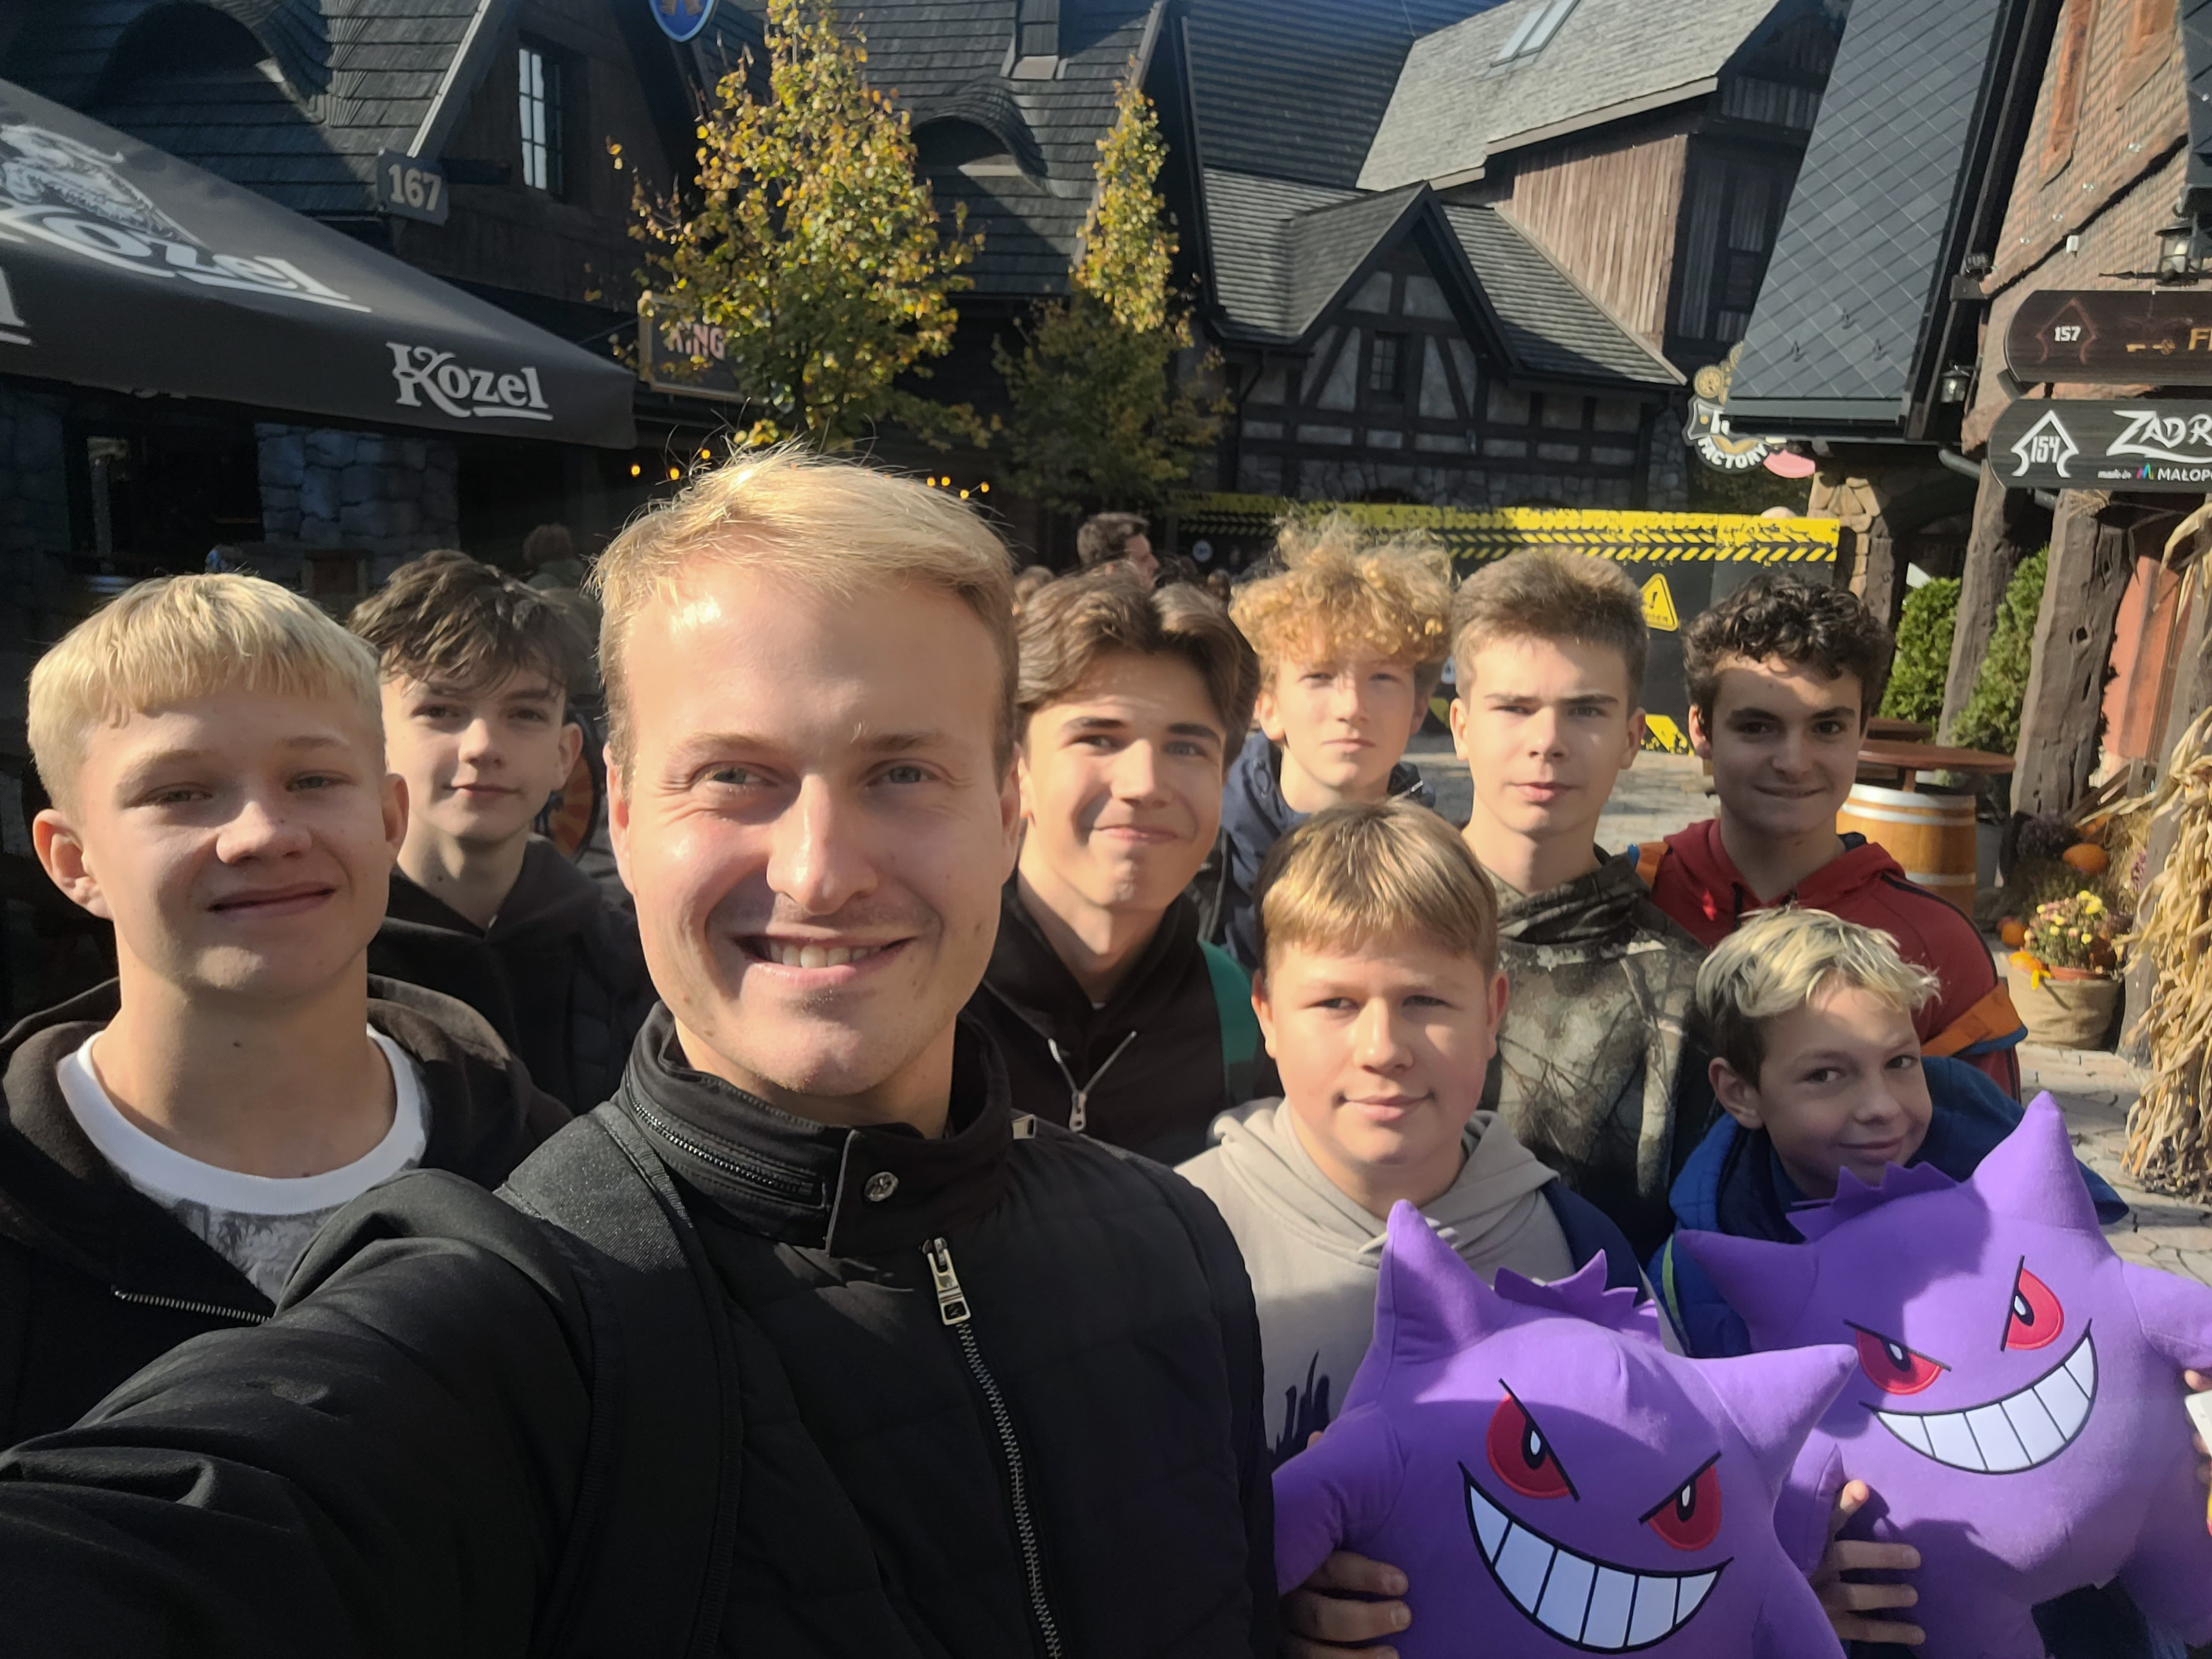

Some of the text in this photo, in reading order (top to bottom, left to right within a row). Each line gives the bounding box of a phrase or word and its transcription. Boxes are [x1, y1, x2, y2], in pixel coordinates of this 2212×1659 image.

[387, 164, 441, 211] 167
[2054, 326, 2081, 341] 157
[385, 341, 554, 421] Kozel
[1697, 435, 1768, 469] FACTORY
[2031, 435, 2060, 463] 154
[2157, 467, 2212, 481] MAŁOP
